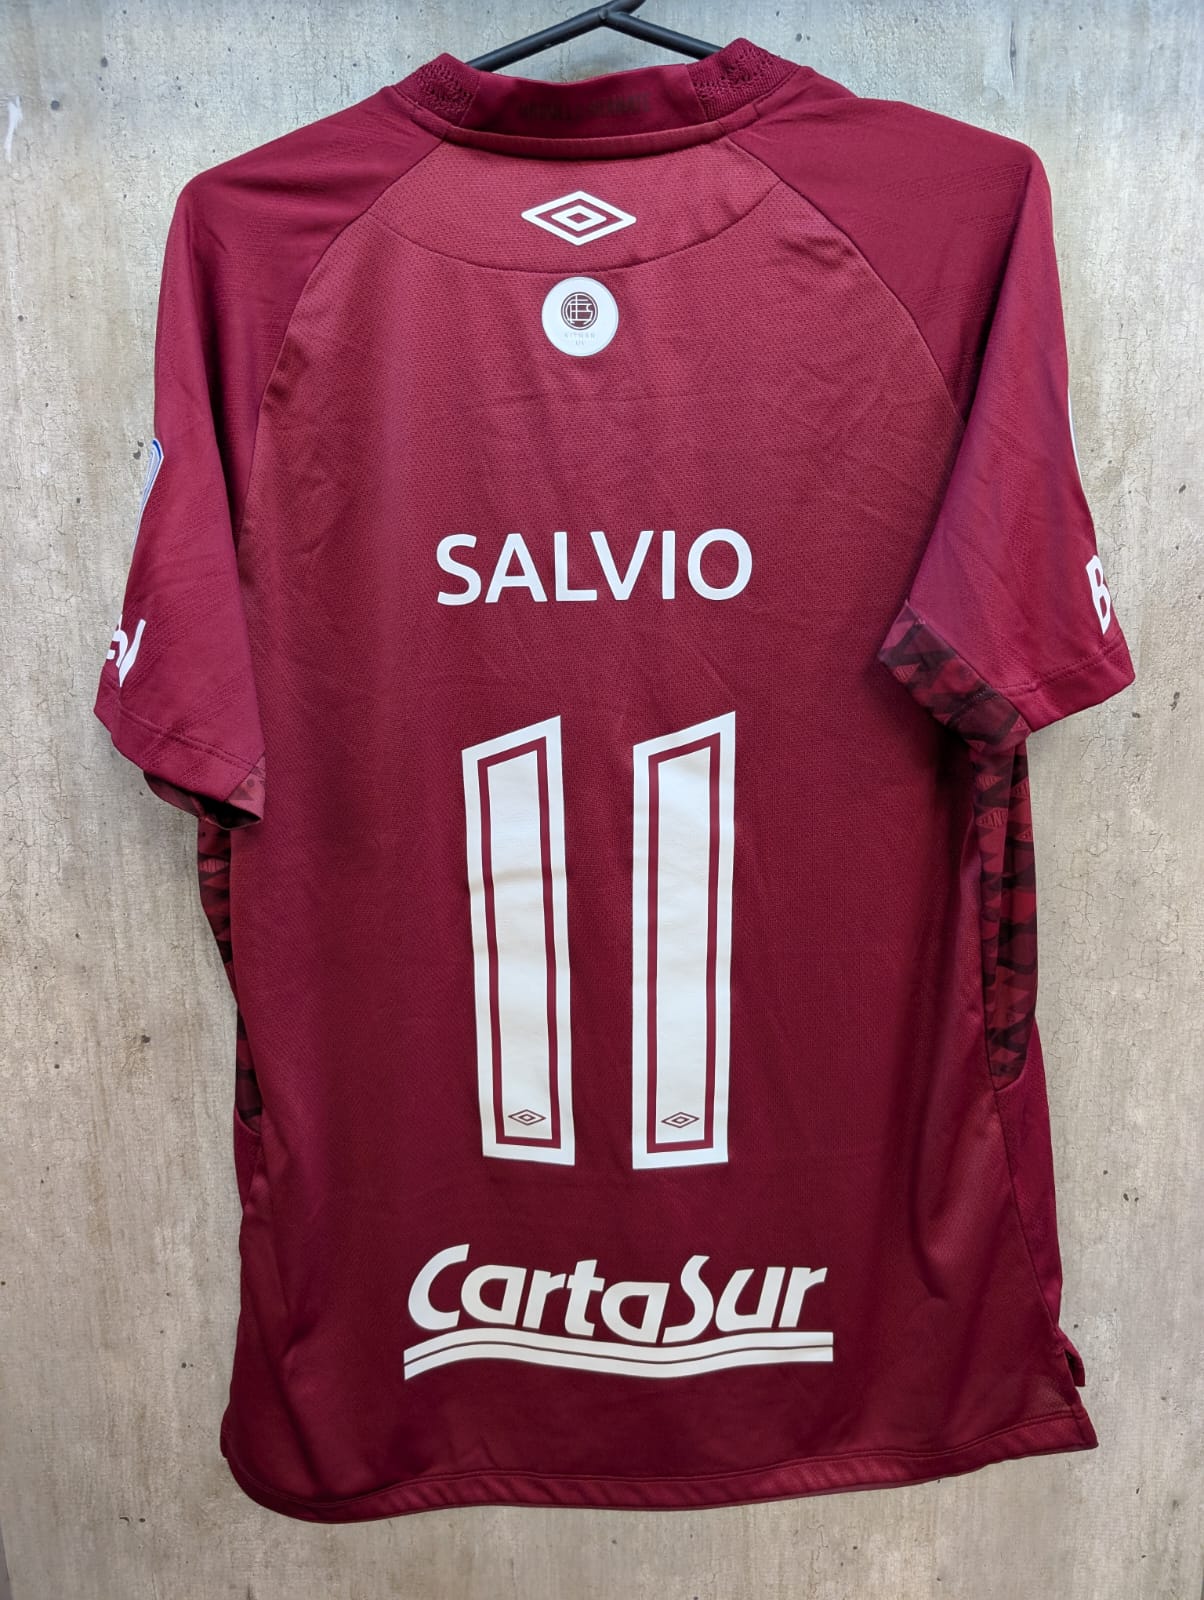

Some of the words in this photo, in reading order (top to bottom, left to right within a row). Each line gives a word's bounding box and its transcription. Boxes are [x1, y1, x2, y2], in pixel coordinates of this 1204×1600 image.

[436, 528, 753, 606] SALVIO
[461, 710, 736, 1170] 11
[407, 1243, 829, 1344] CartaSur
